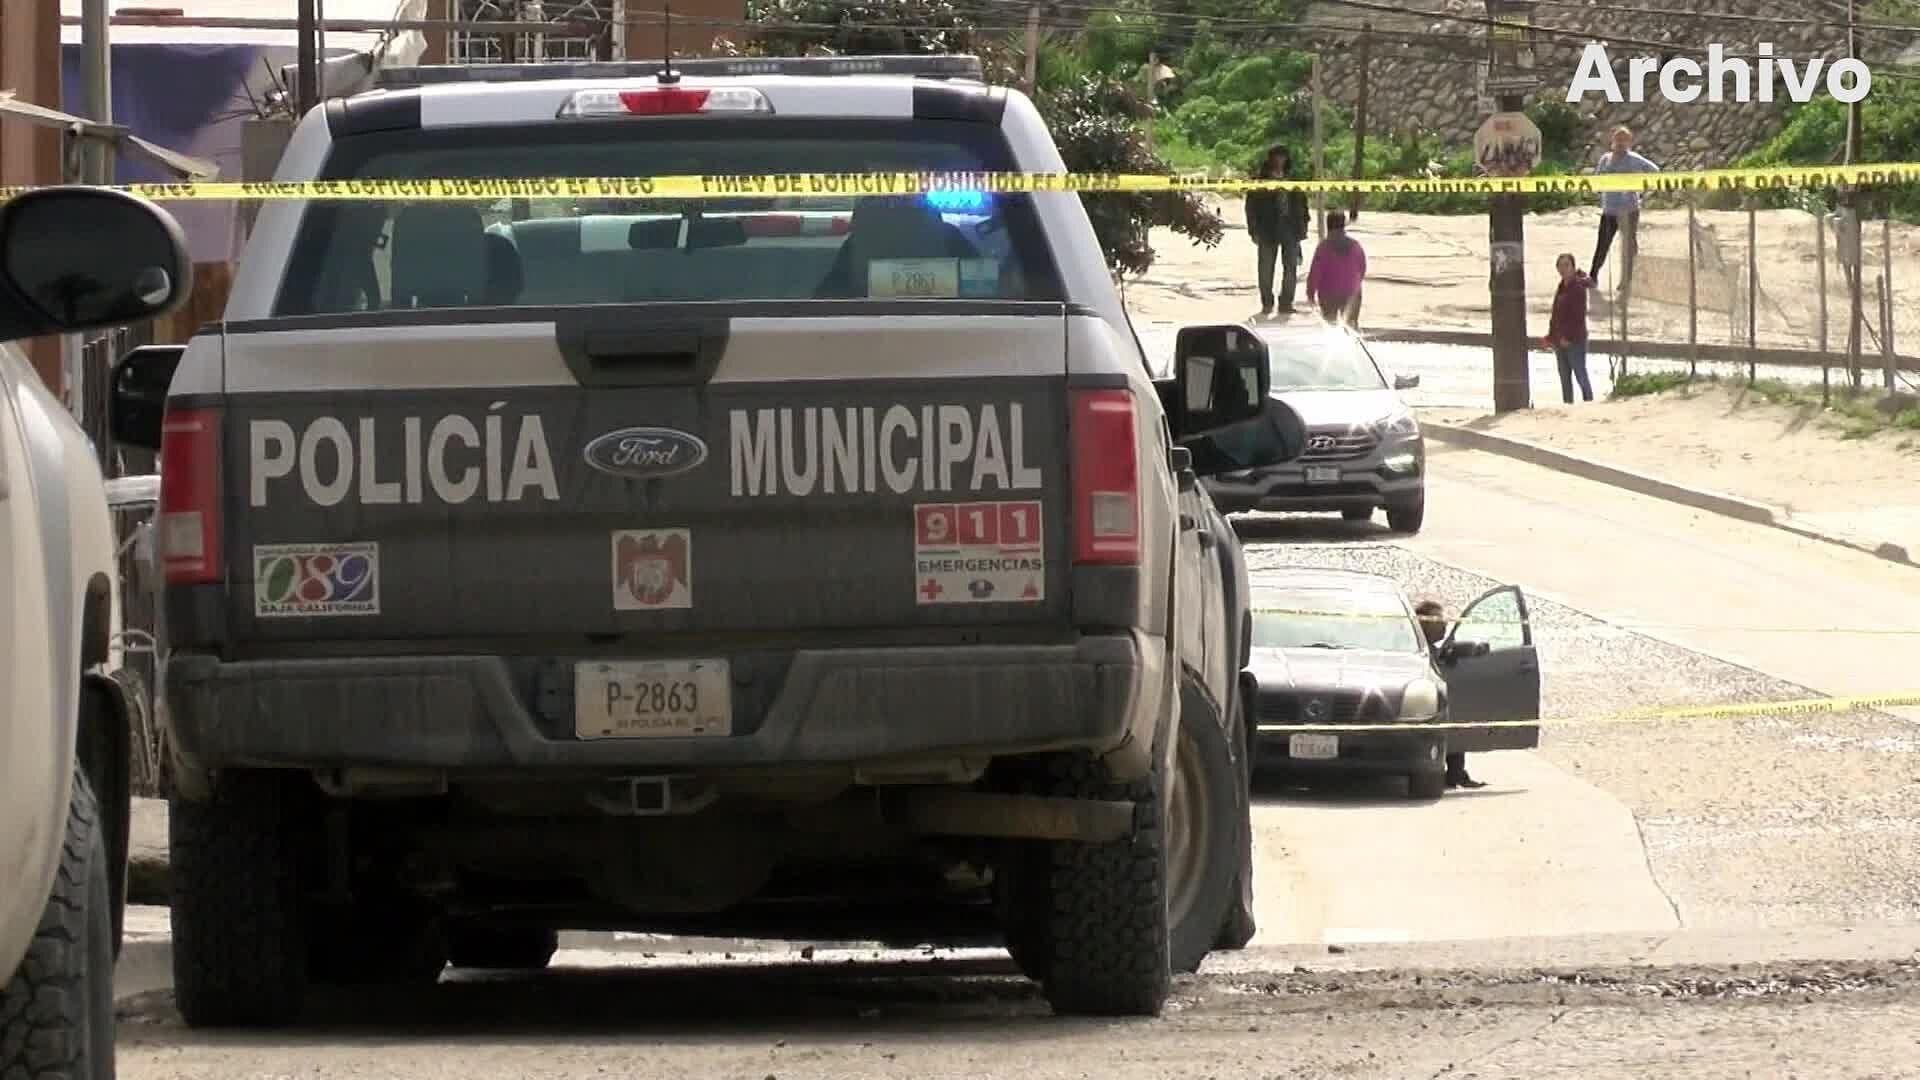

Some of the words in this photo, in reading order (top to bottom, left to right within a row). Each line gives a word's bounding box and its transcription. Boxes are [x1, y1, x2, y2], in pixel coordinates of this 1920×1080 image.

[249, 401, 560, 507] POLICÍA
[612, 438, 679, 466] Ford
[729, 403, 1042, 497] MUNICIPAL
[263, 552, 372, 603] 089
[918, 558, 1042, 573] EMERGENCIAS
[607, 680, 698, 717] P-2863
